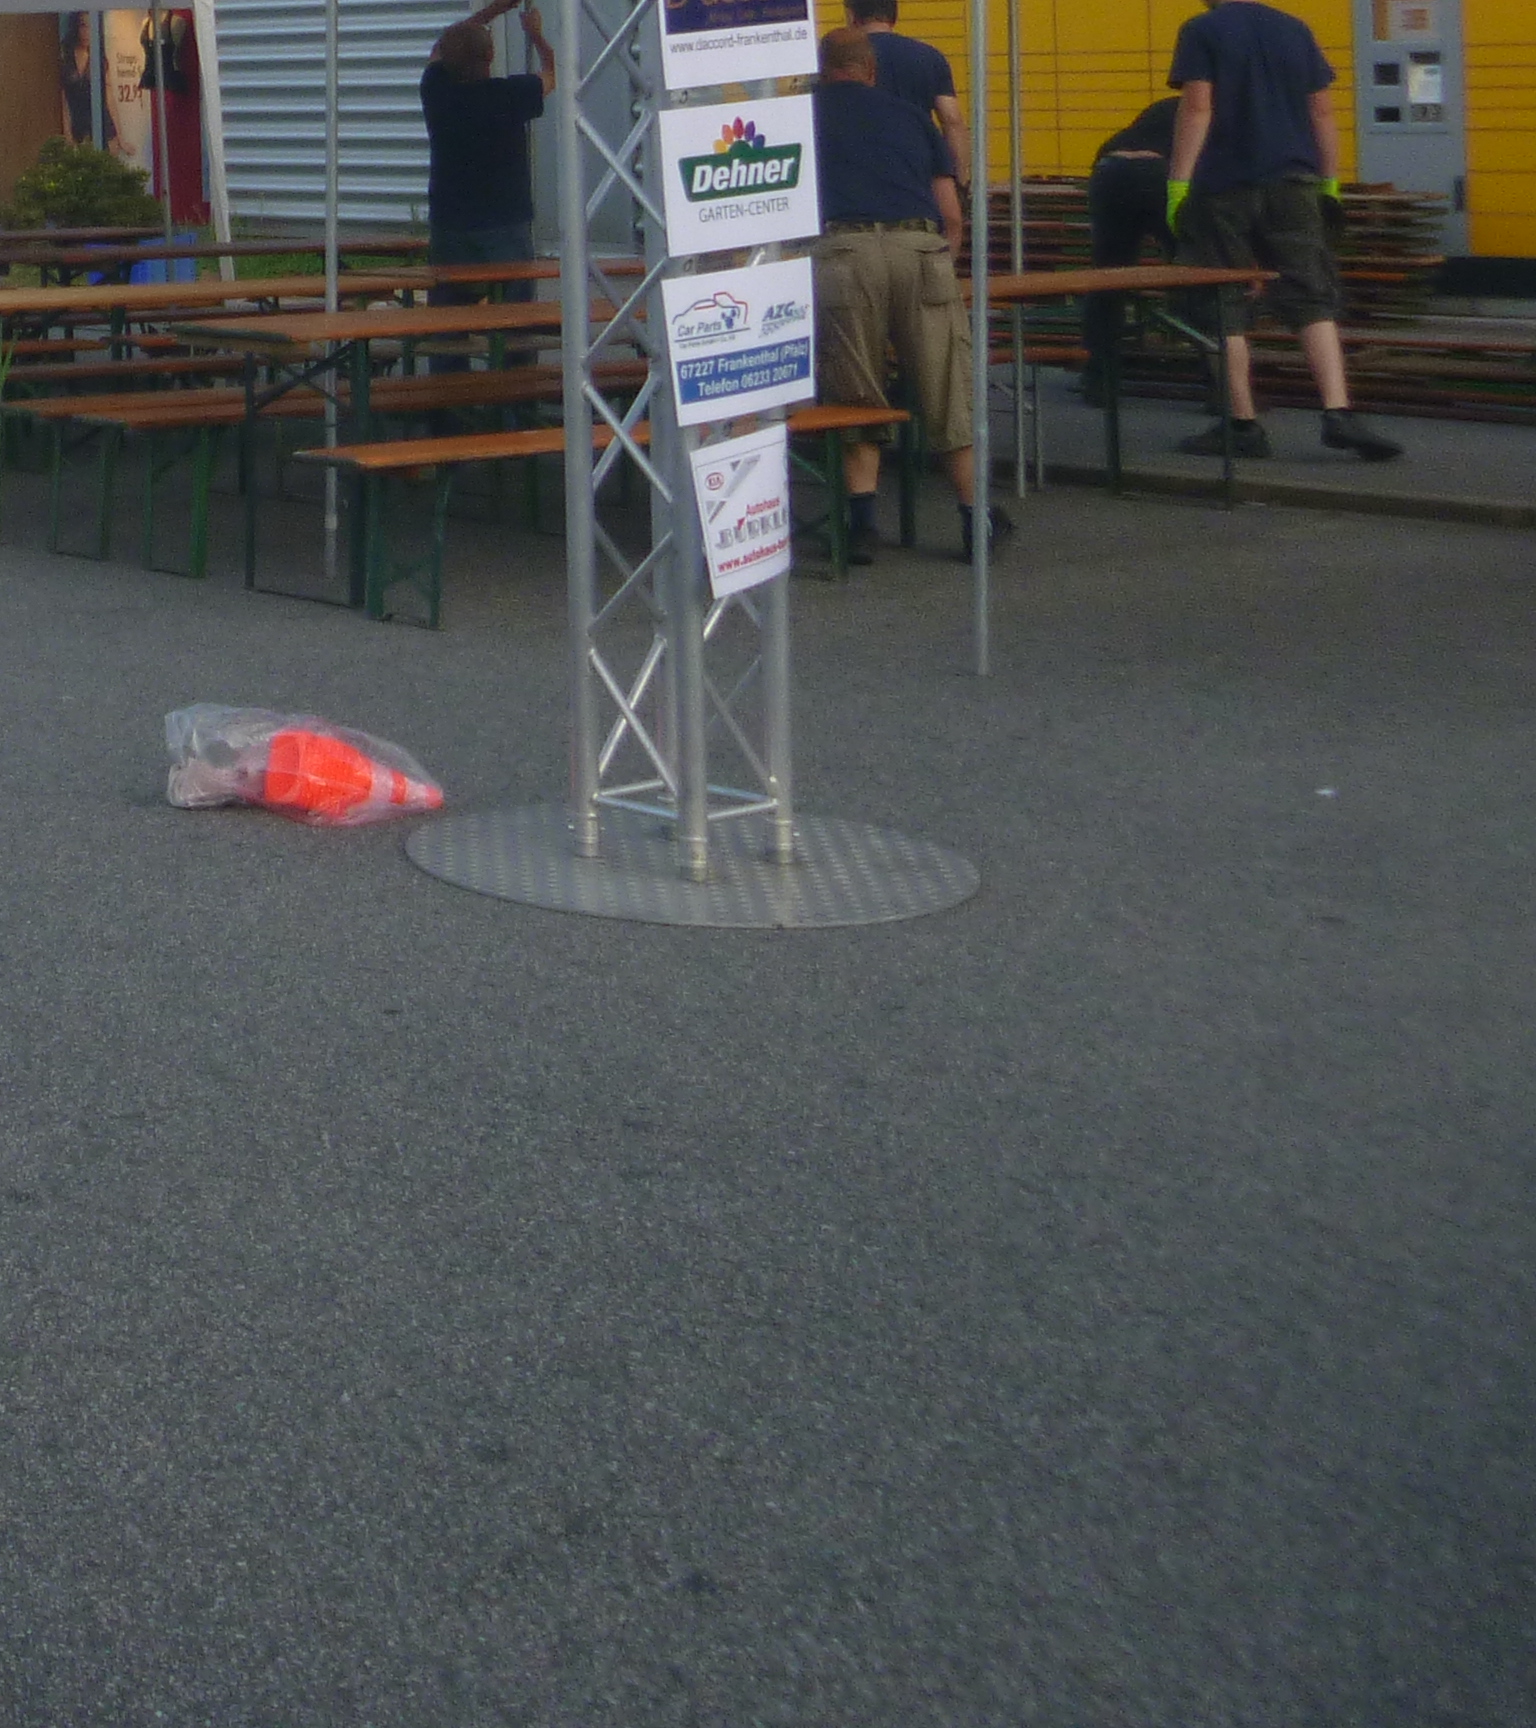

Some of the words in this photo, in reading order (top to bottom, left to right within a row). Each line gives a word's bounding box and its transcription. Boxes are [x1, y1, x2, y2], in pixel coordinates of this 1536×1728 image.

[669, 27, 808, 54] www.daccord-frankenthal.de
[692, 157, 795, 194] Dehner
[699, 197, 789, 222] GARTEN-CENTER
[678, 325, 694, 337] Car
[697, 321, 722, 334] Parts
[680, 361, 715, 379] 67227
[718, 348, 779, 373] Frankenthal
[698, 380, 739, 397] Telefon
